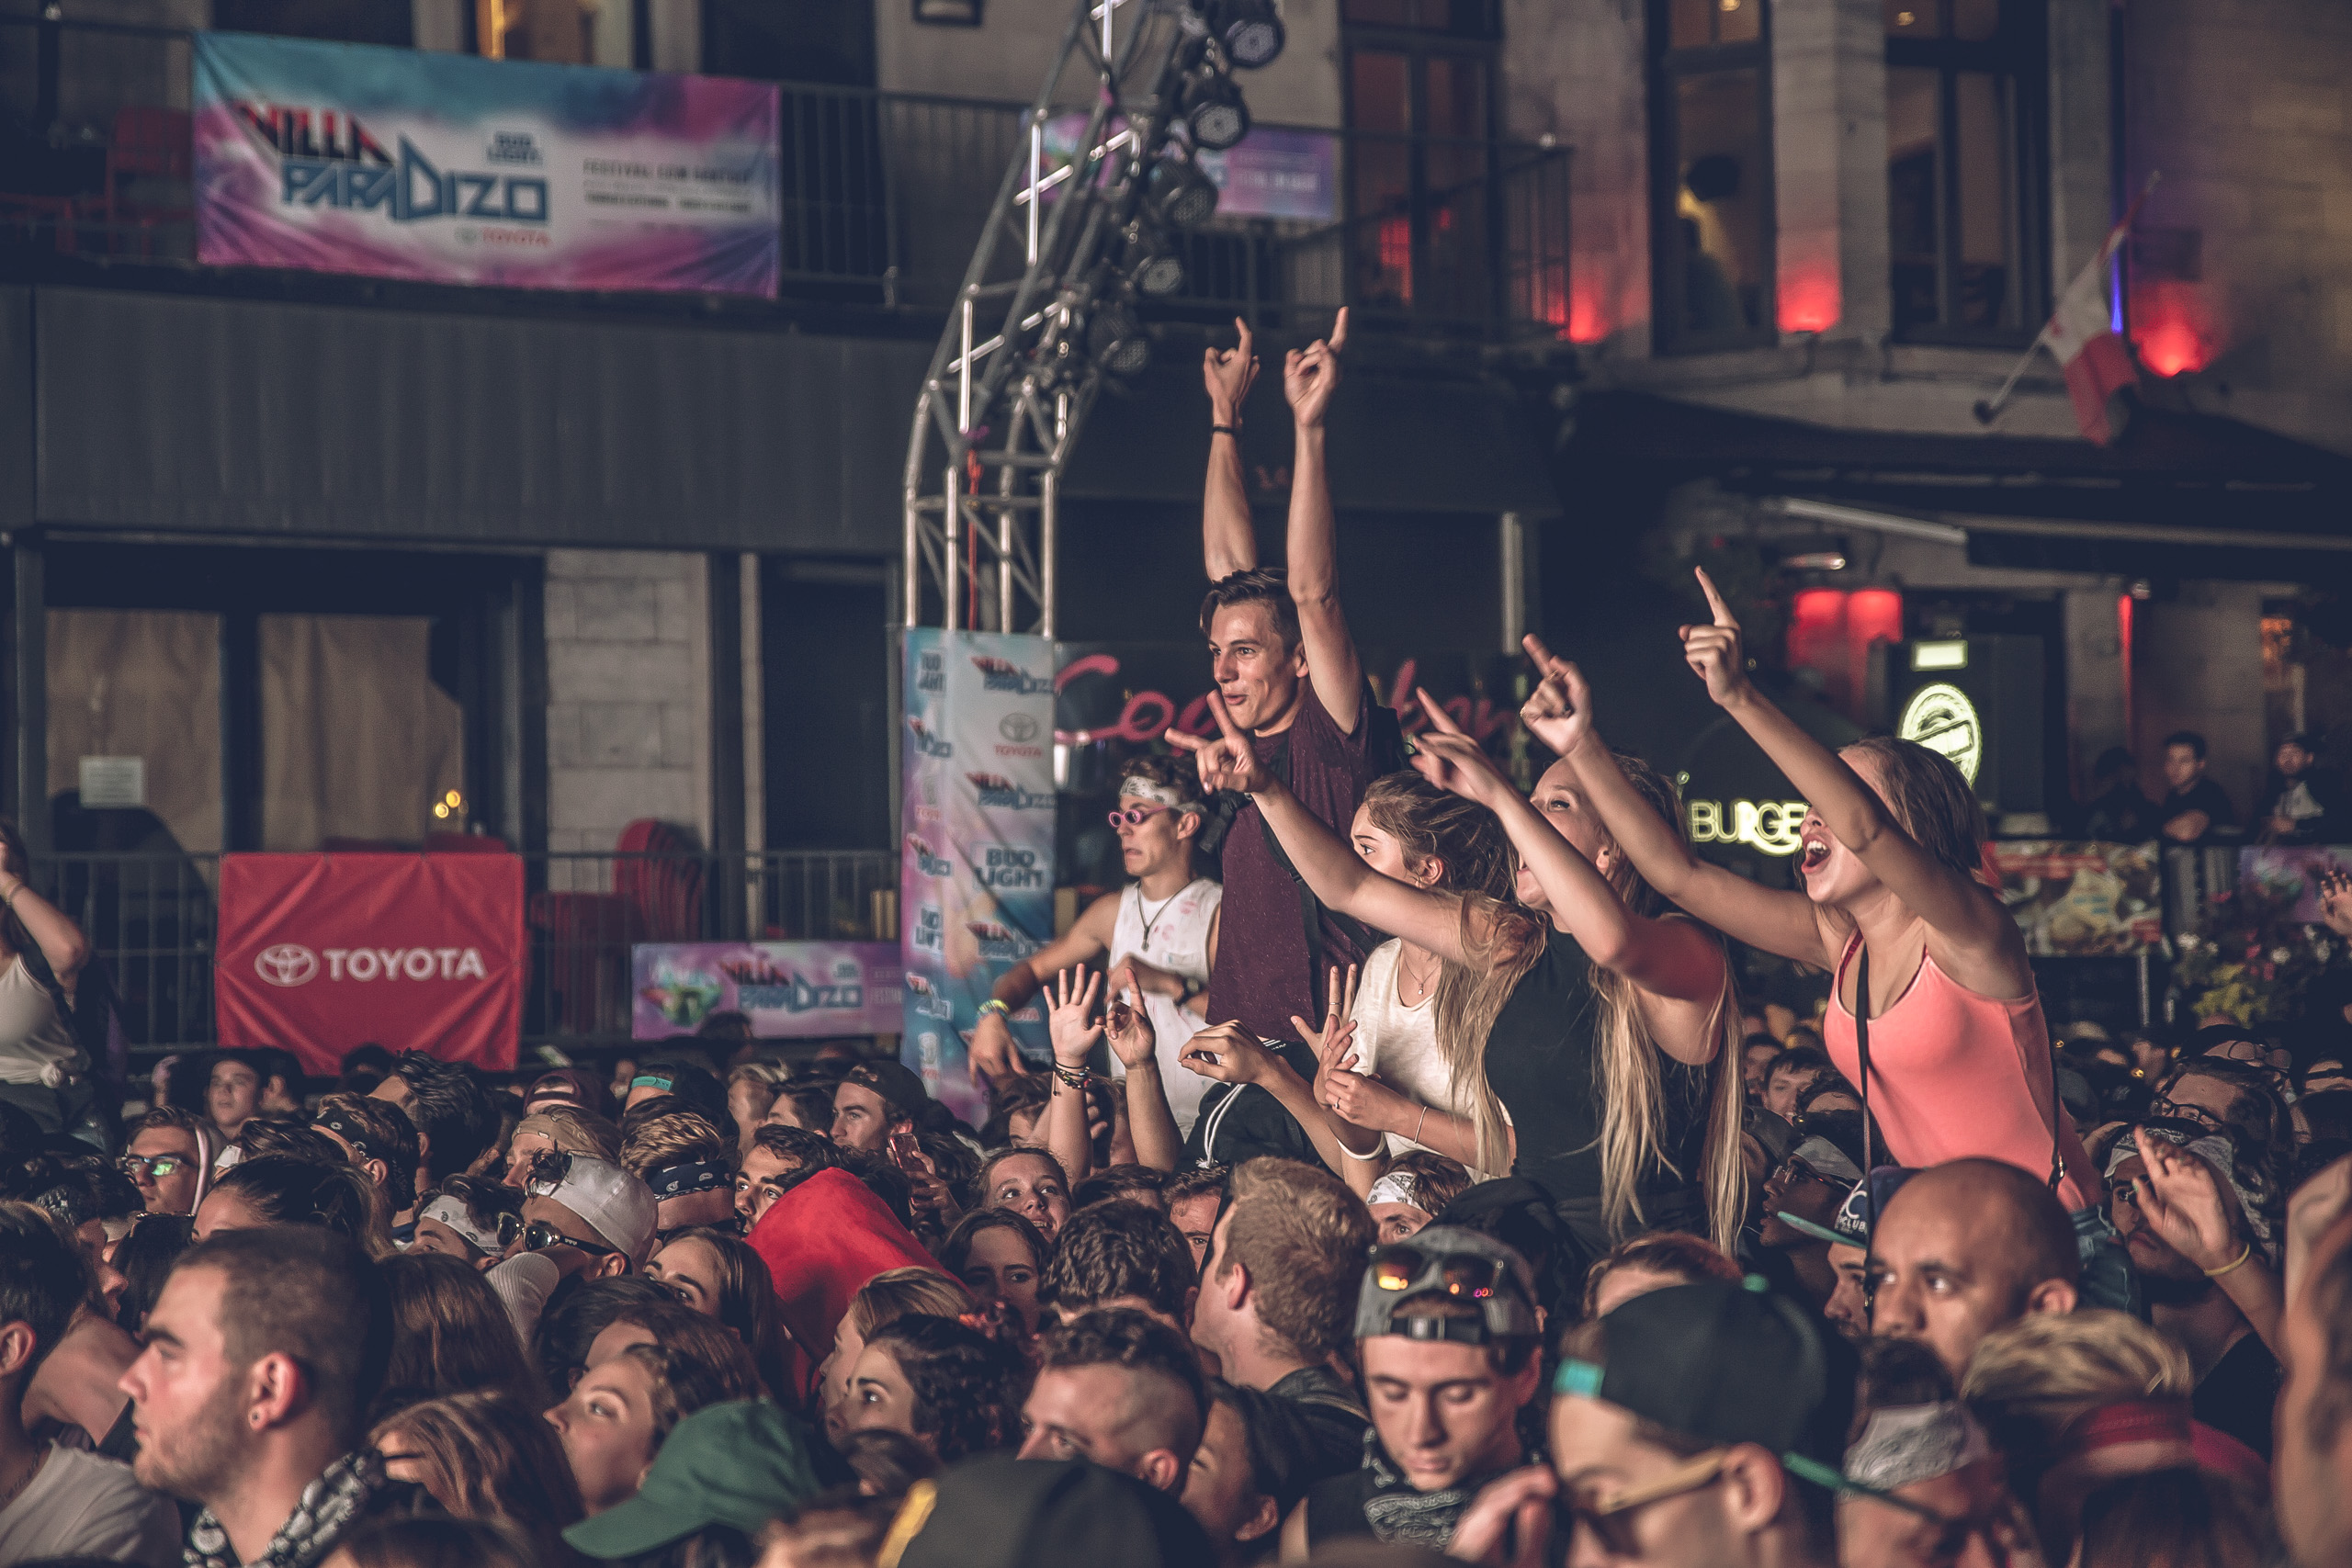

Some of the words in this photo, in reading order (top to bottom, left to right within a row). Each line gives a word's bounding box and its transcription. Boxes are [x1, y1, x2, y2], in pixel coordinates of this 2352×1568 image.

[281, 131, 548, 222] PARADIZO
[995, 744, 1043, 759] TOYOTA
[1690, 799, 1807, 857] BURGE
[986, 848, 1035, 868] BUD
[322, 946, 489, 982] TOYOTA
